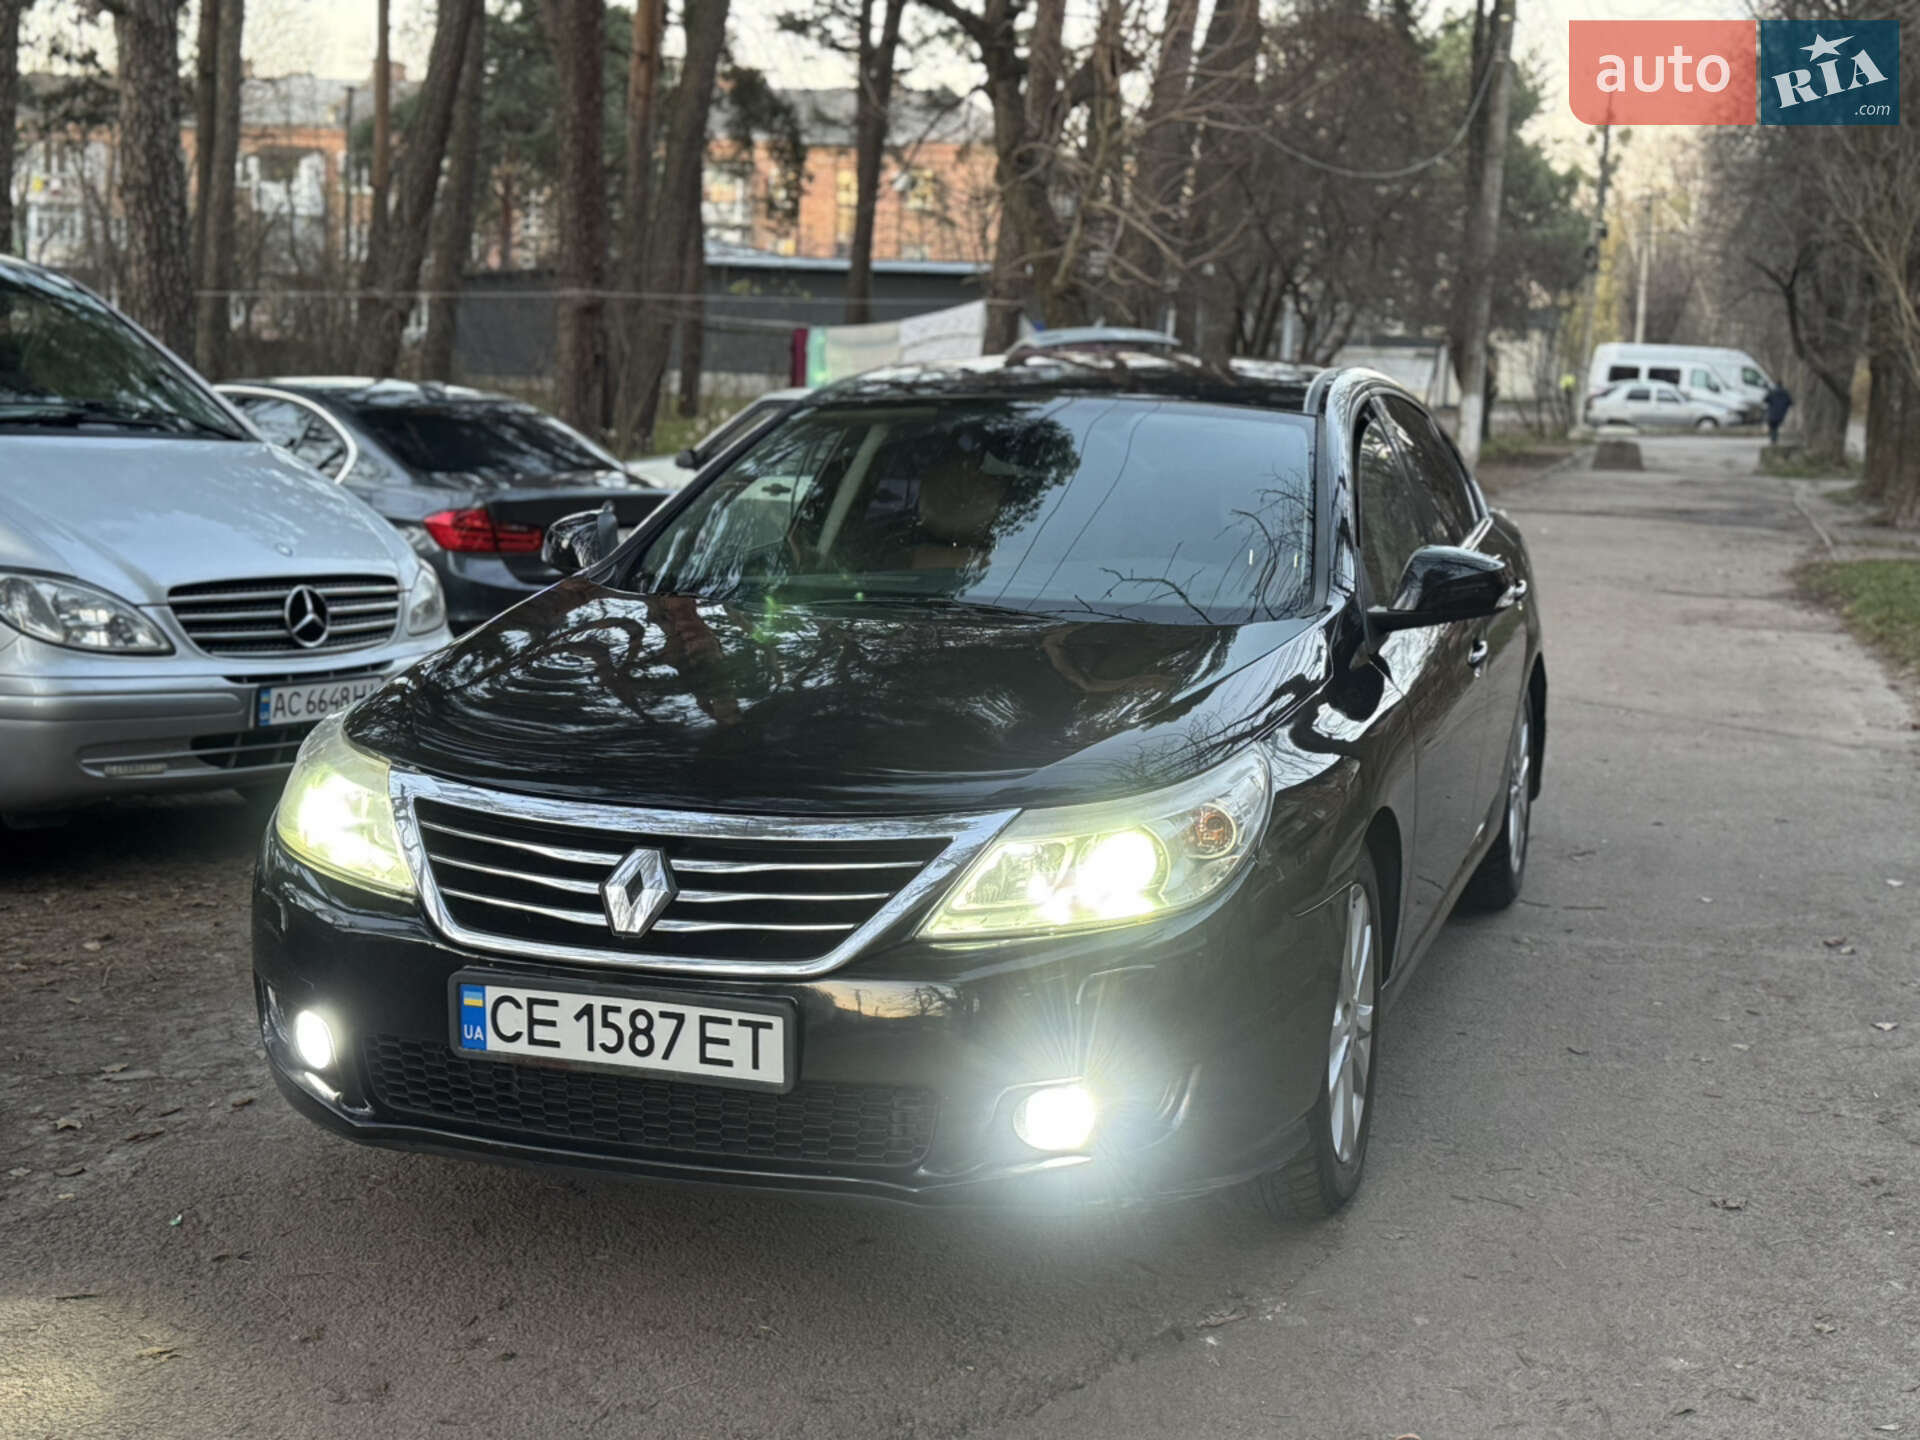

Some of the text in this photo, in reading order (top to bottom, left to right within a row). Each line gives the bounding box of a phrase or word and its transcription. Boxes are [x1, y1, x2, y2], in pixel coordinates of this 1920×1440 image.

[274, 684, 374, 718] AC 6648 H
[463, 1024, 485, 1041] UA
[490, 995, 774, 1070] CE 1587 ET
